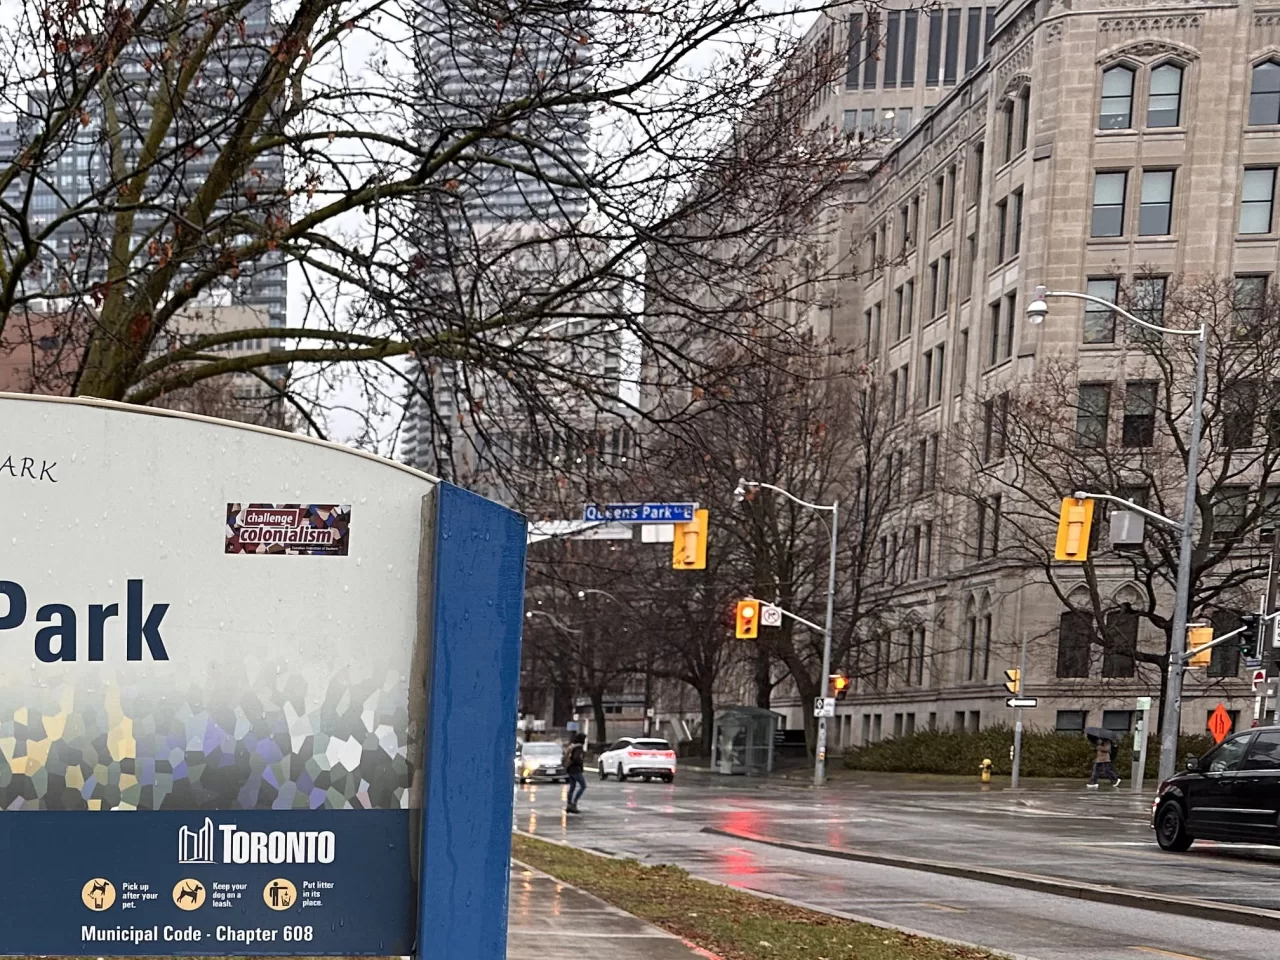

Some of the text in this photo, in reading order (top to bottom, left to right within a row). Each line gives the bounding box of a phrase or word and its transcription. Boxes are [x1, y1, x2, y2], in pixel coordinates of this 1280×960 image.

[642, 506, 673, 519] Park
[247, 512, 293, 526] challenge
[240, 525, 332, 542] colonialism
[219, 824, 336, 864] TORONTO
[122, 882, 149, 892] Pick up
[212, 882, 248, 892] Keep your
[302, 880, 335, 889] Put litter
[122, 891, 159, 901] after your
[212, 891, 226, 901] dog
[311, 890, 321, 898] its
[122, 901, 137, 910] pet.
[212, 899, 232, 908] leash.
[302, 898, 323, 908] place.
[81, 925, 158, 945] Municipal
[163, 925, 202, 942] Code
[216, 925, 279, 945] Chapter
[283, 925, 313, 942] 608
